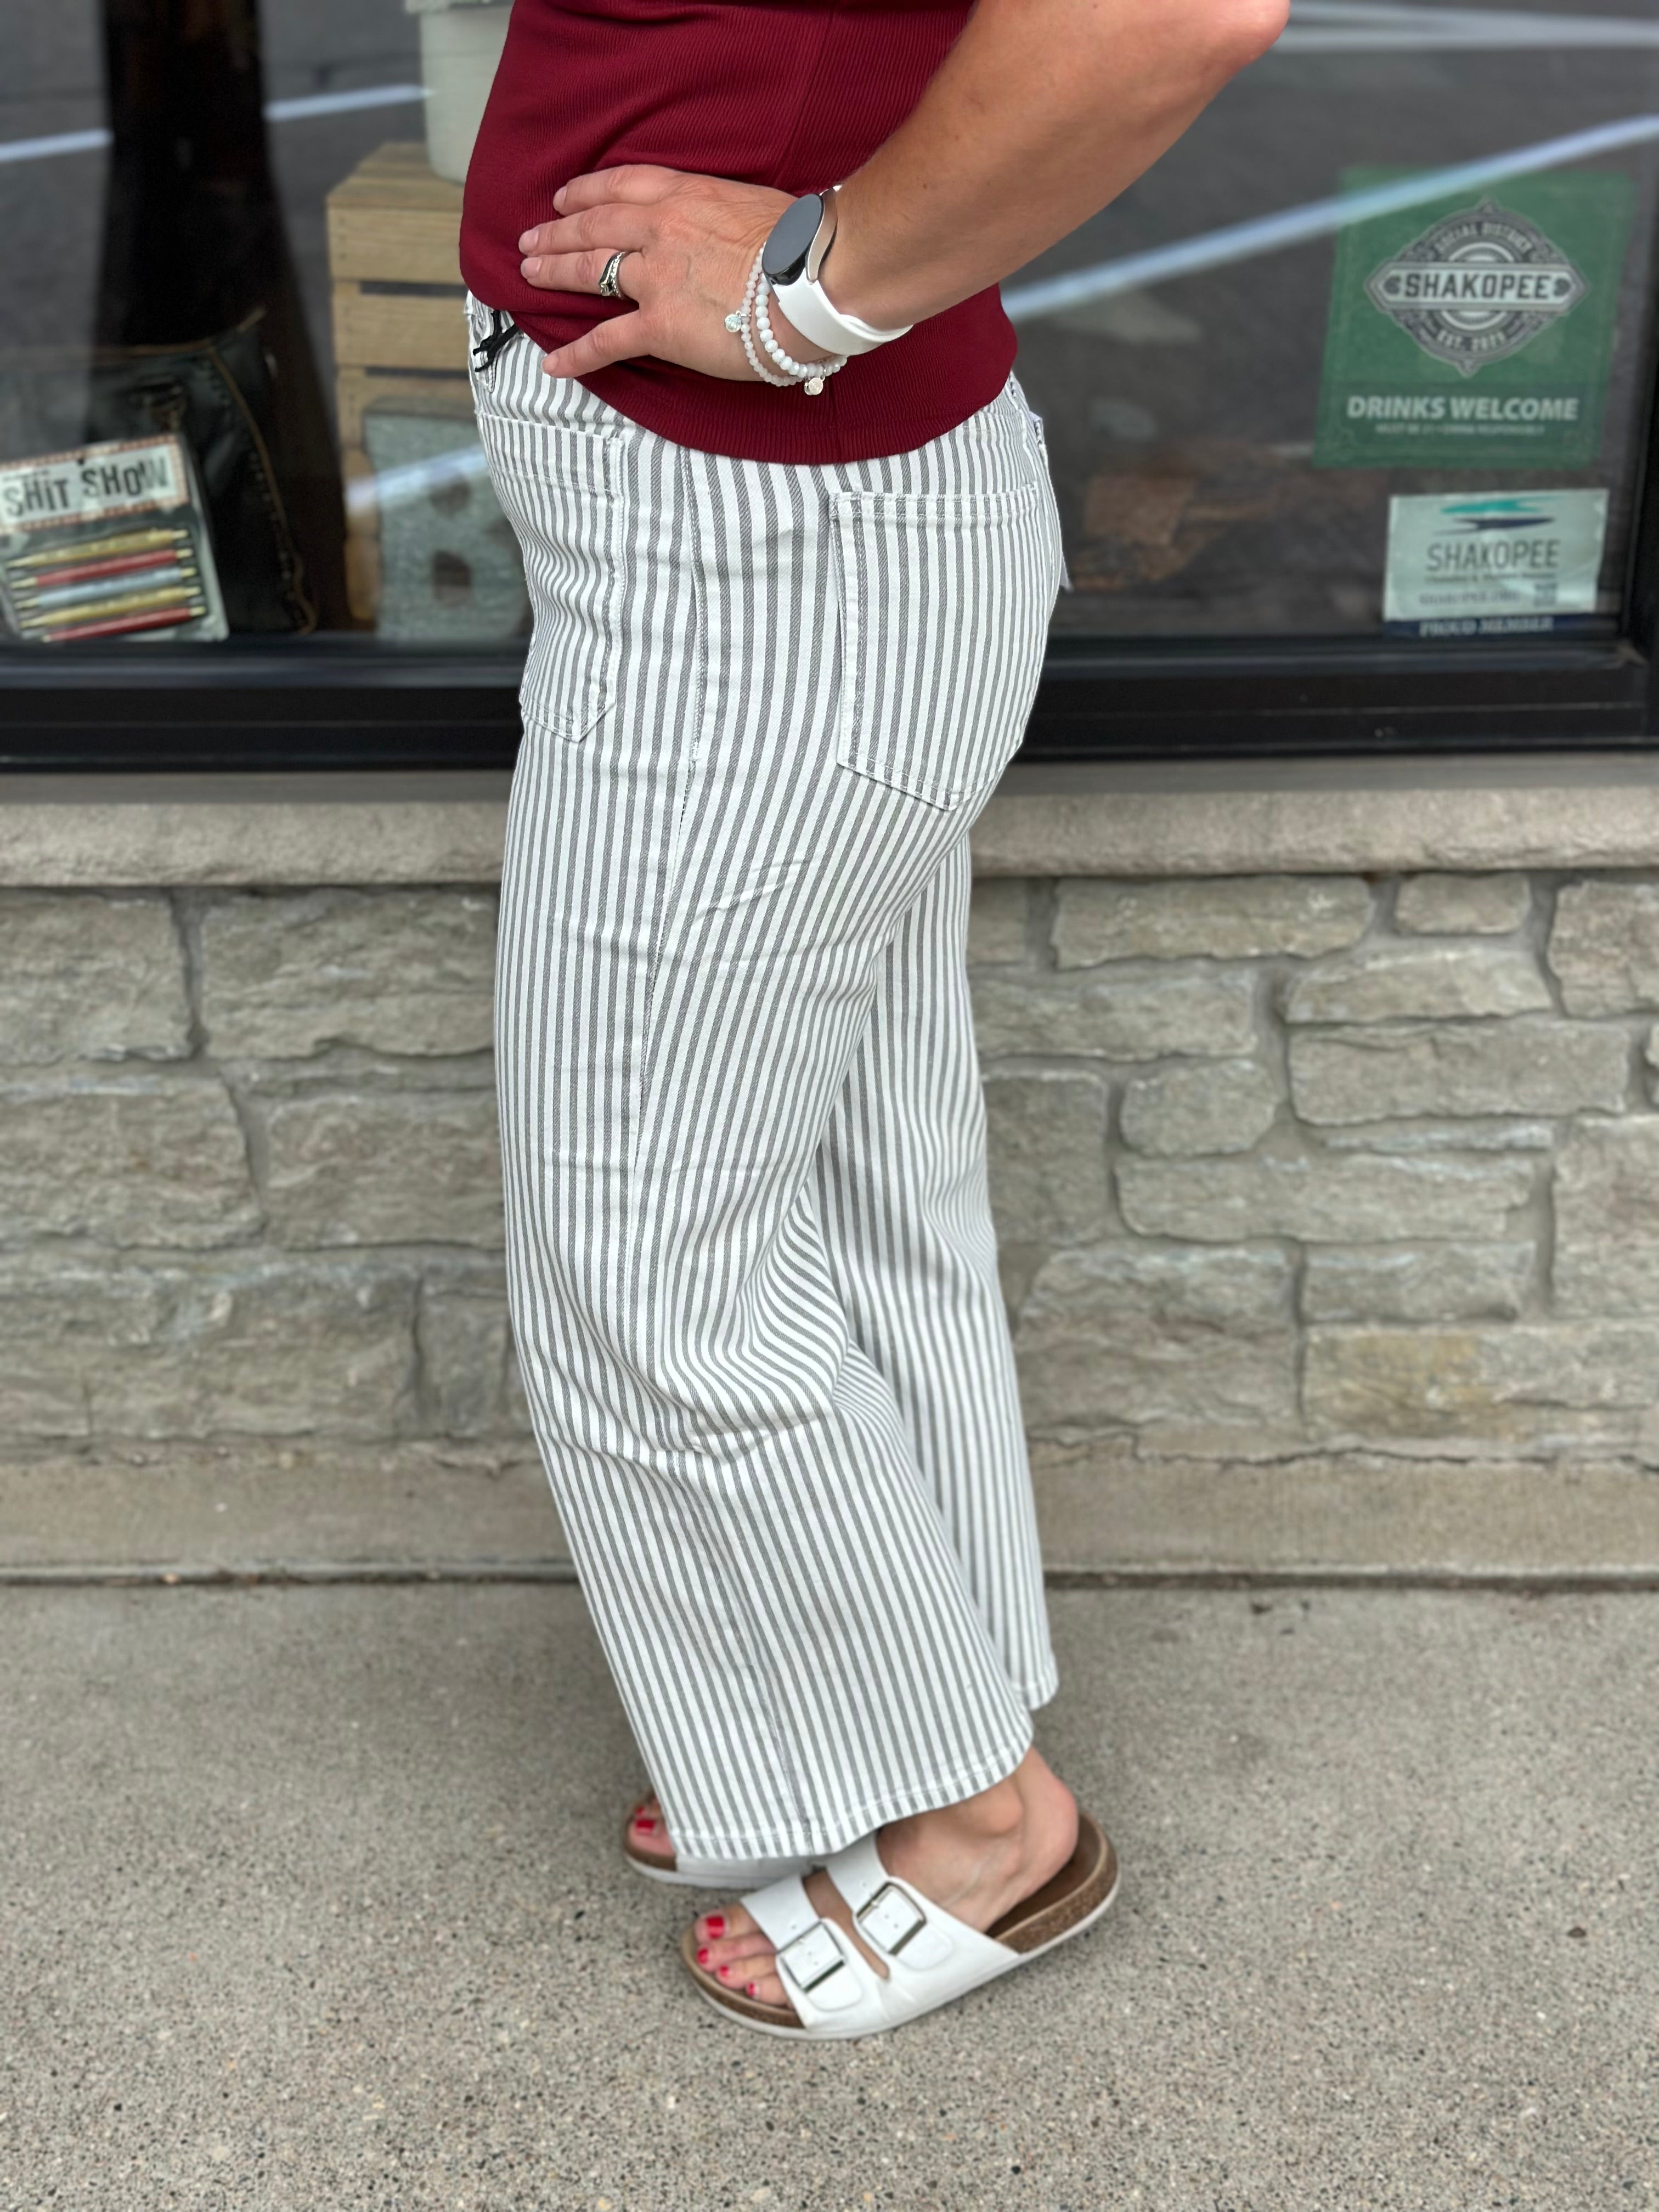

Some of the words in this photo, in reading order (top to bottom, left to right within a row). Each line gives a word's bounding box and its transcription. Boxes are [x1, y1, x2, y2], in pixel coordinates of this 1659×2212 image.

[1404, 272, 1551, 300] SHAKOPEE
[1346, 396, 1446, 419] DRINKS
[1449, 396, 1579, 421] WELCOME
[80, 456, 168, 498] SHOW
[1425, 538, 1561, 572] SHAKOPEE
